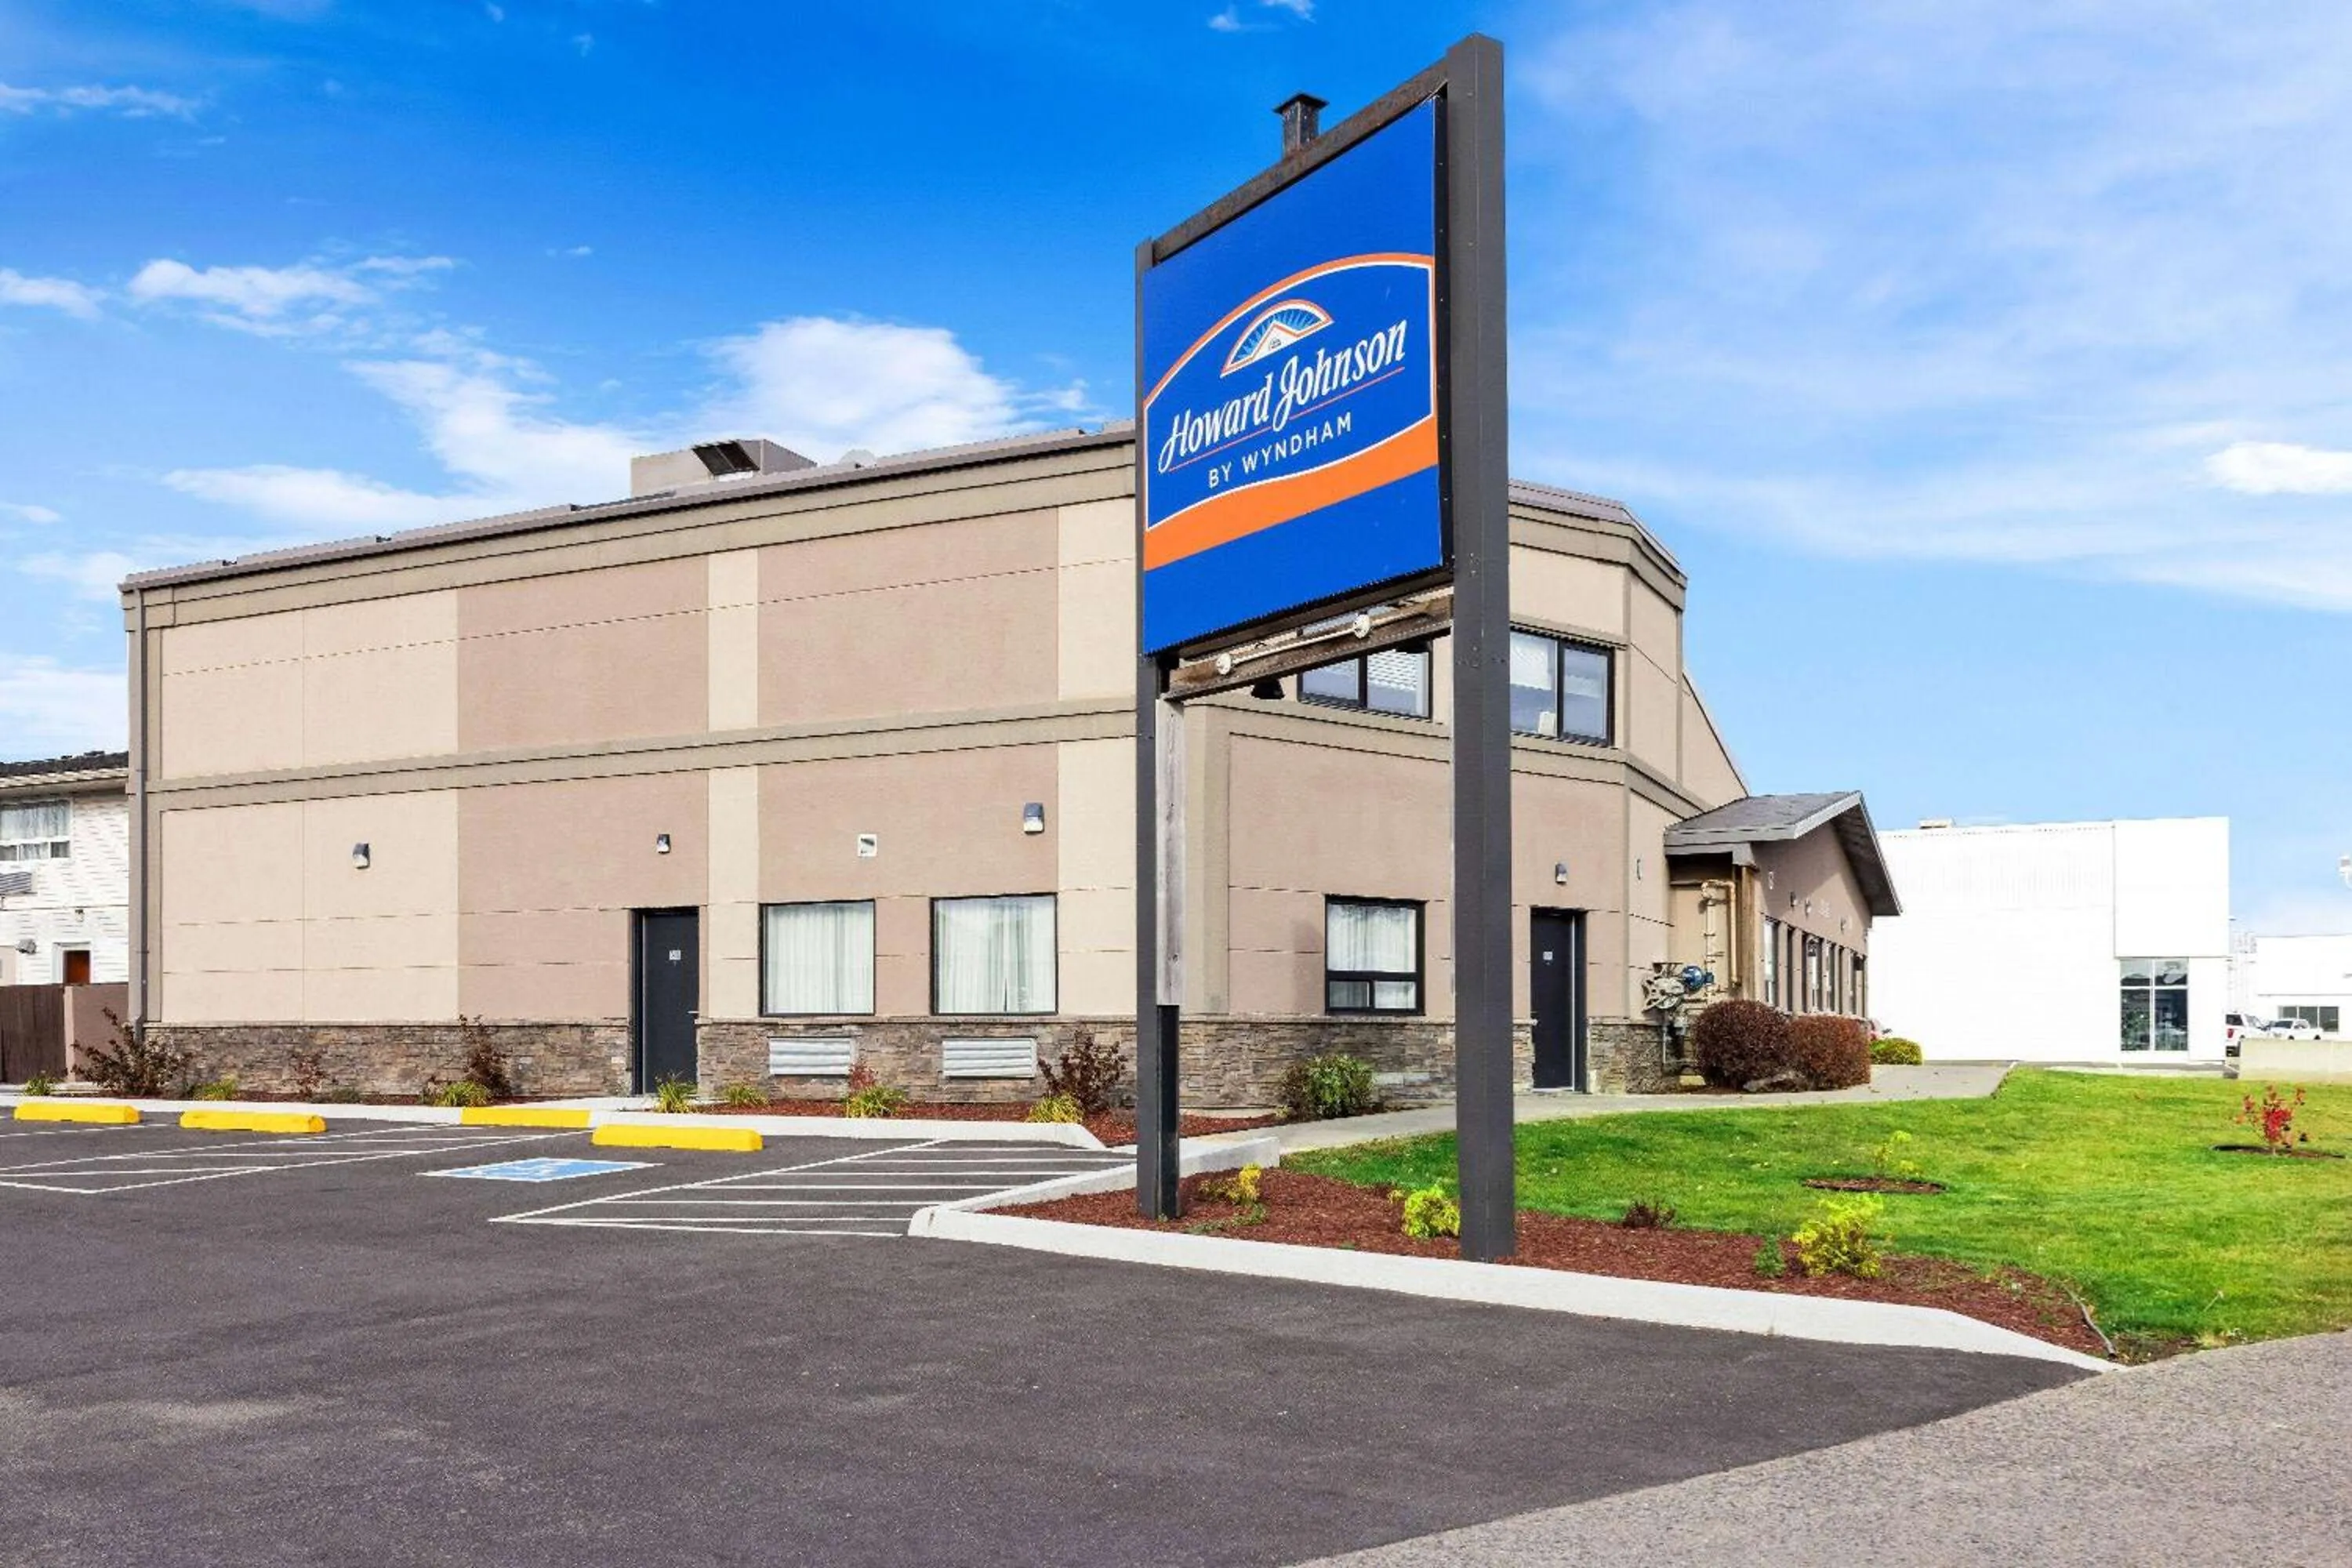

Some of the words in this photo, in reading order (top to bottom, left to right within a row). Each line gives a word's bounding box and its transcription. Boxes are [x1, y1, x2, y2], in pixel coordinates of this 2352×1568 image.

[1158, 373, 1273, 474] Howard
[1272, 319, 1407, 432] Johnson
[1208, 462, 1233, 488] BY
[1242, 412, 1352, 474] WYNDHAM
